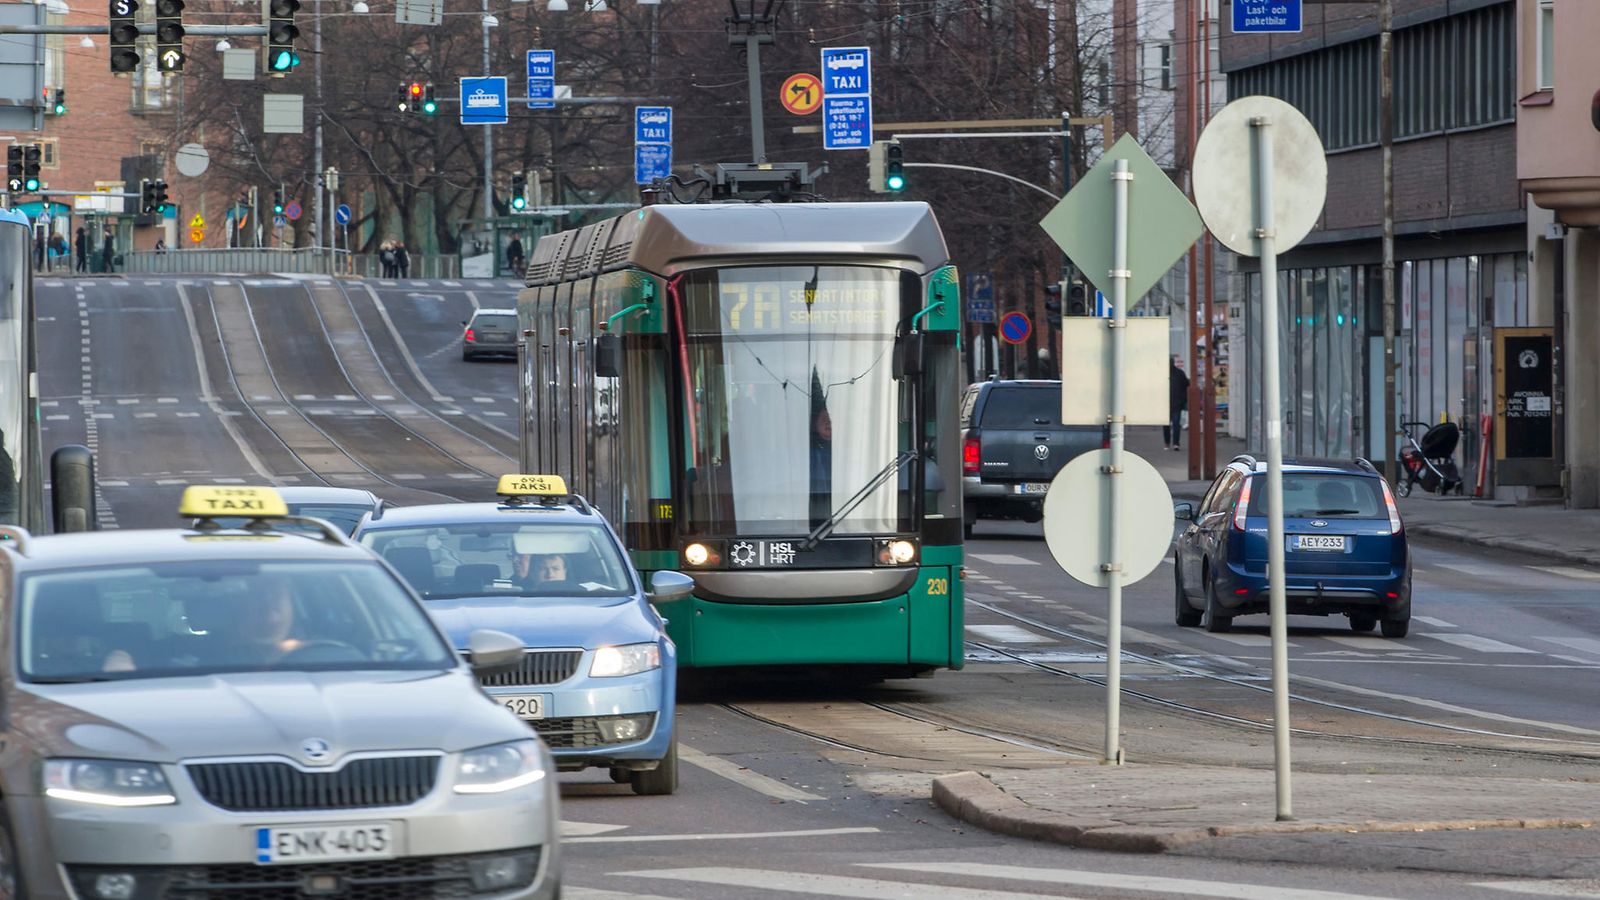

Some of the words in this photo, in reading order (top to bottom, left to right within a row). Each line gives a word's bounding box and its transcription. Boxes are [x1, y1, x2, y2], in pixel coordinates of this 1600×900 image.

[1271, 6, 1287, 15] och
[1245, 17, 1287, 27] paketbilar
[832, 75, 862, 88] TAXI
[643, 128, 666, 138] TAXI
[511, 482, 552, 491] TAKSI
[205, 499, 264, 510] TAXI
[769, 542, 796, 553] HSL
[1300, 537, 1343, 548] AEY-233
[769, 553, 796, 564] HRT
[927, 578, 948, 595] 230
[277, 828, 389, 856] ENK-403
